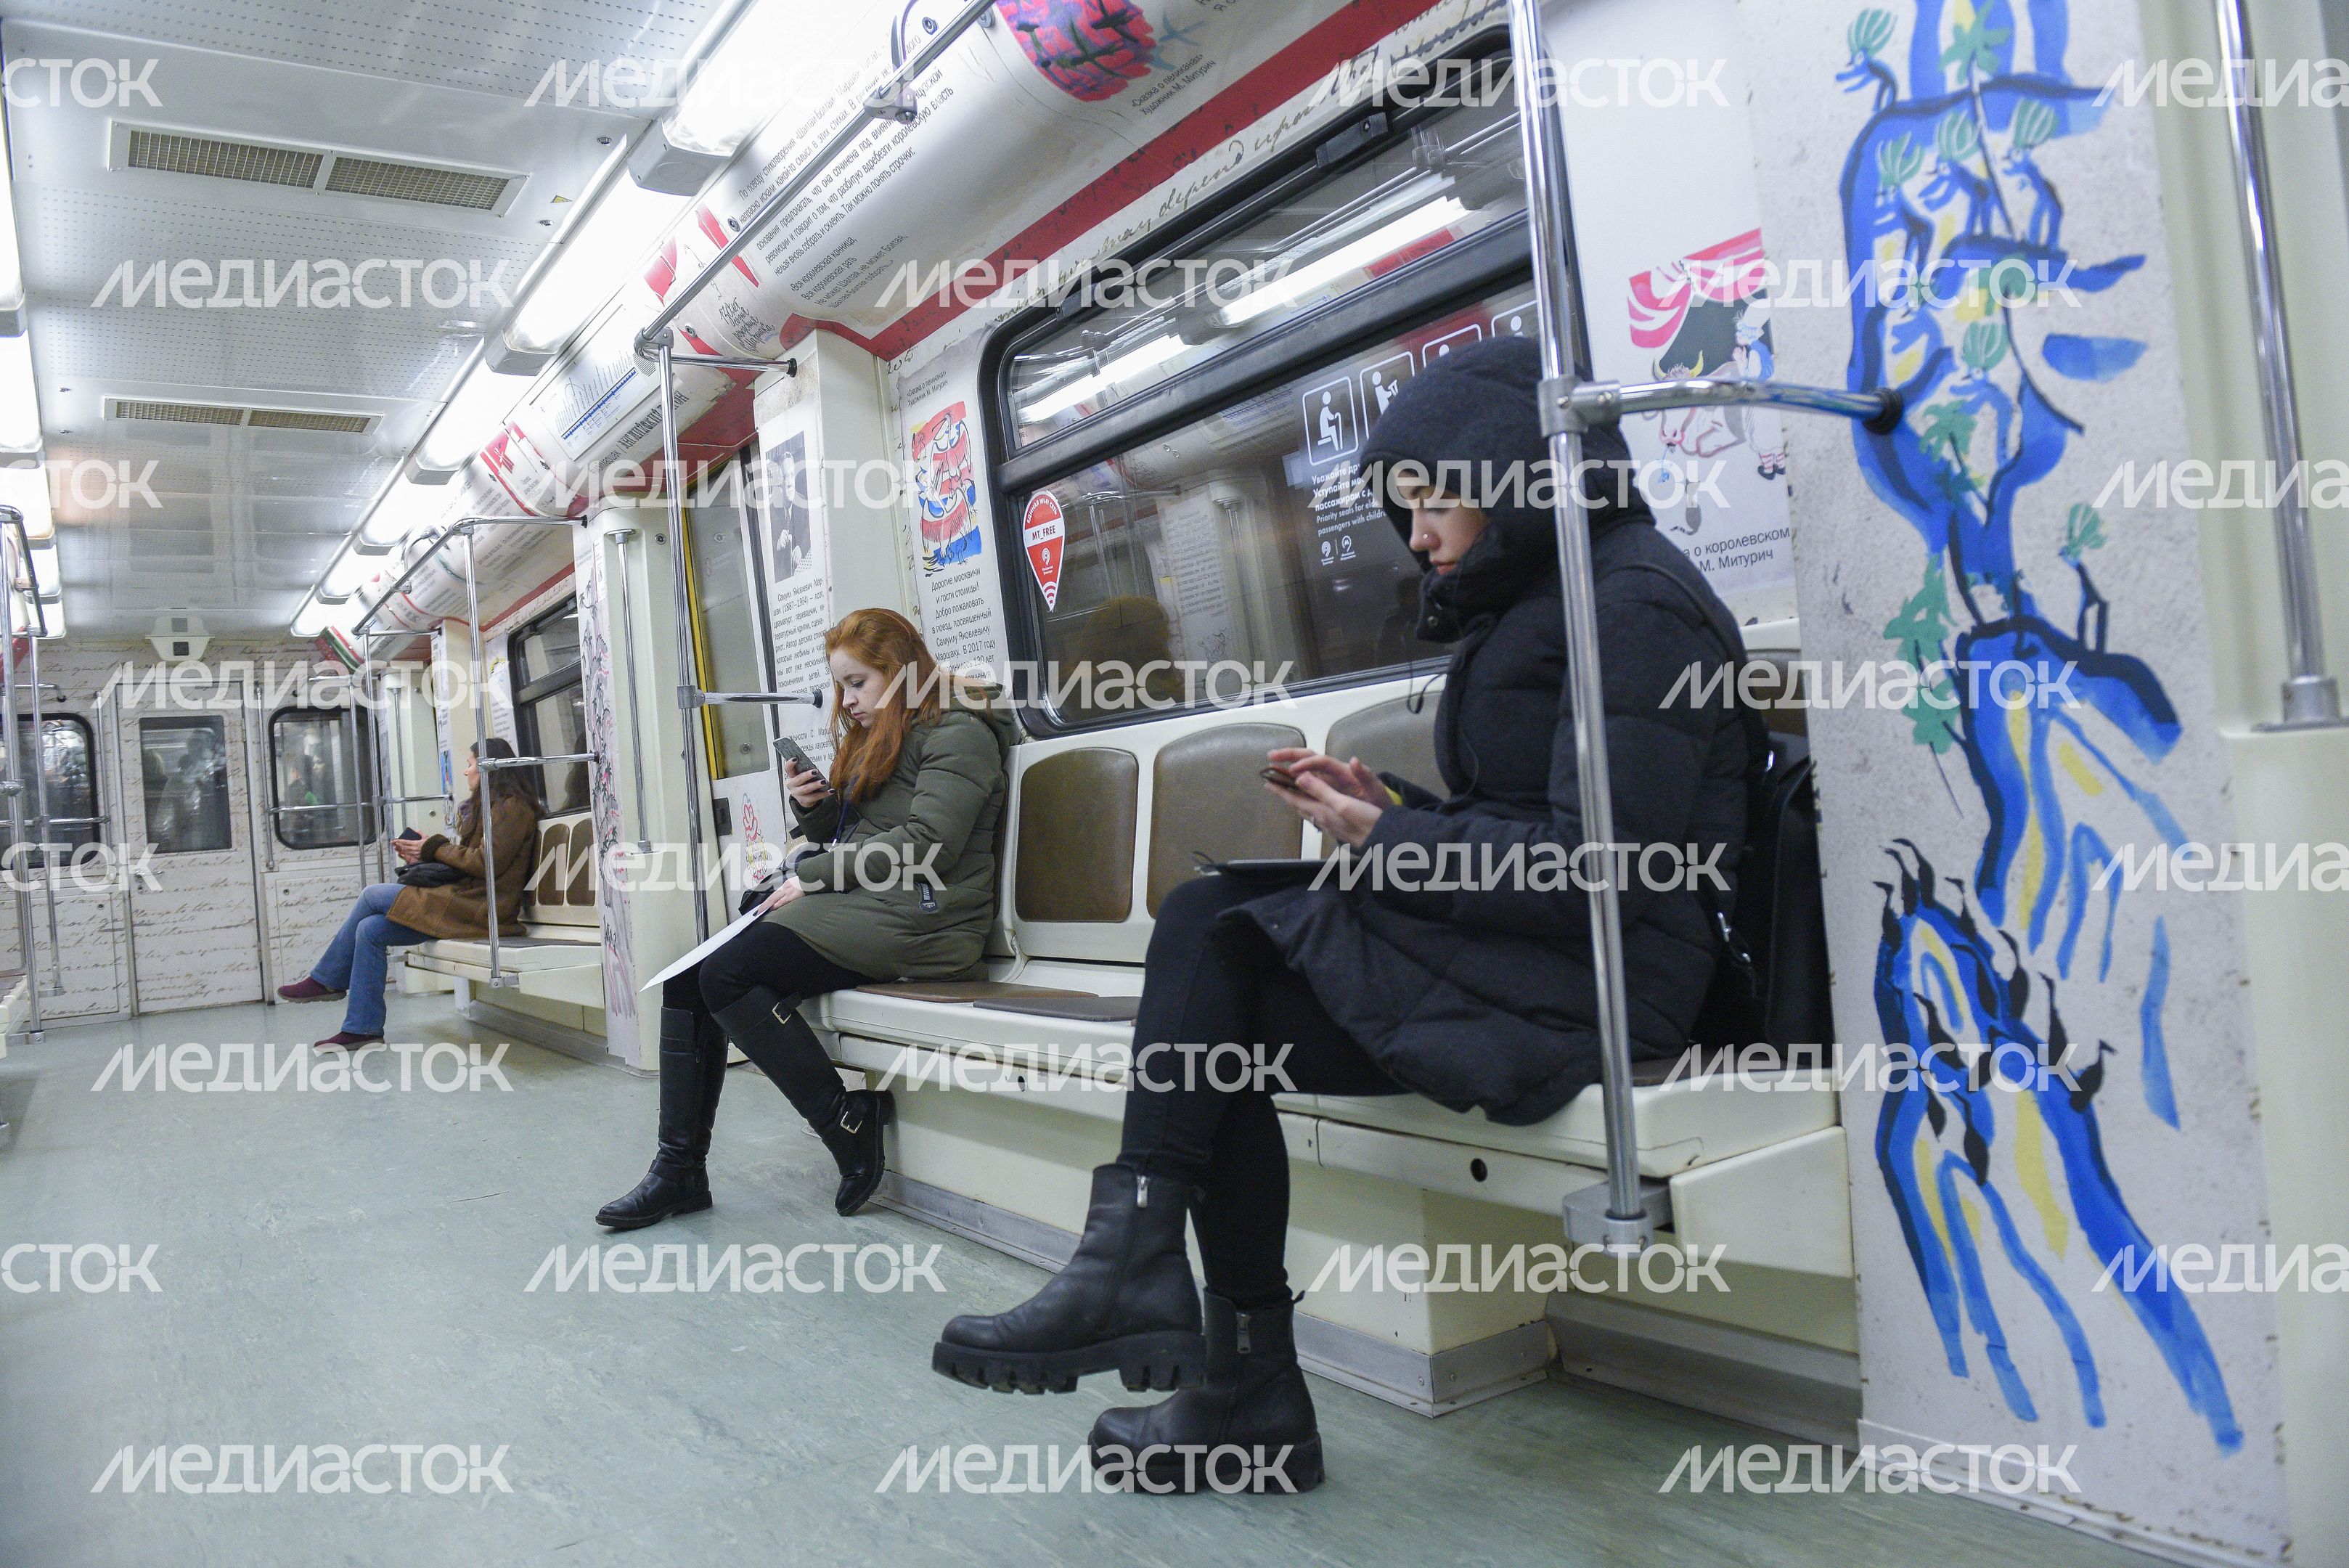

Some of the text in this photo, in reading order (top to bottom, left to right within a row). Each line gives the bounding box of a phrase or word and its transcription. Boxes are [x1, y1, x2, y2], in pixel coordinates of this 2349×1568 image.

[1132, 87, 1159, 107] «Сказка
[1163, 54, 1204, 84] пеликанах»
[1140, 60, 1217, 115] Художник М. Митурич
[738, 200, 761, 224] напрасно
[759, 184, 777, 203] искали
[775, 163, 796, 187] какой-то
[796, 147, 813, 166] смысл
[817, 129, 831, 143] этих
[848, 99, 857, 110] В
[738, 189, 748, 200] По
[747, 173, 765, 192] поводу
[762, 139, 796, 176] стихотворения
[765, 237, 791, 265] революции
[794, 216, 813, 237] говорит
[817, 203, 830, 216] том,
[828, 193, 838, 204] что
[838, 170, 863, 198] разбитую
[862, 143, 893, 173] вдребезги
[891, 107, 931, 146] королевскую
[931, 87, 954, 110] власть
[756, 225, 781, 250] основания
[780, 196, 813, 228] предполагать,
[812, 185, 822, 197] что
[822, 175, 833, 188] она
[833, 150, 859, 176] сочинена
[859, 138, 873, 152] под
[774, 259, 791, 277] нельзя
[788, 248, 804, 264] вновь
[802, 232, 822, 252] собрать
[824, 212, 846, 232] склеить.
[841, 200, 855, 213] Так
[853, 186, 873, 206] можно
[871, 168, 891, 190] понять
[801, 256, 834, 282] королевская
[830, 237, 858, 258] конница,
[801, 256, 857, 301] Вся королевская рать
[814, 296, 827, 306] Не
[825, 285, 843, 301] может
[866, 249, 886, 266] может
[1312, 467, 1347, 486] Уважайте
[1313, 481, 1350, 498] Уступайте
[1315, 494, 1360, 512] пассажирам
[1316, 511, 1337, 523] Priority
[1339, 508, 1355, 518] seats
[1318, 520, 1351, 538] passengers
[1352, 515, 1365, 526] with
[1031, 525, 1055, 541] MT_FREE
[1694, 547, 1702, 556] о
[1705, 527, 1790, 554] королевском
[1699, 549, 1773, 572] М. Митурич
[777, 592, 791, 602] Самуил
[793, 582, 813, 595] Яковлевич
[931, 568, 981, 592] Дорогие москвичи
[940, 592, 955, 603] гости
[955, 581, 979, 597] столицы!
[935, 597, 984, 621] Добро пожаловать
[936, 622, 952, 633] поезд,
[953, 608, 992, 628] посвященный
[785, 640, 797, 649] Автор
[936, 626, 990, 647] Самуилу Яковлевичу
[776, 653, 792, 665] которые
[935, 639, 996, 663] Маршаку. В 2017 году
[985, 654, 994, 663] лет
